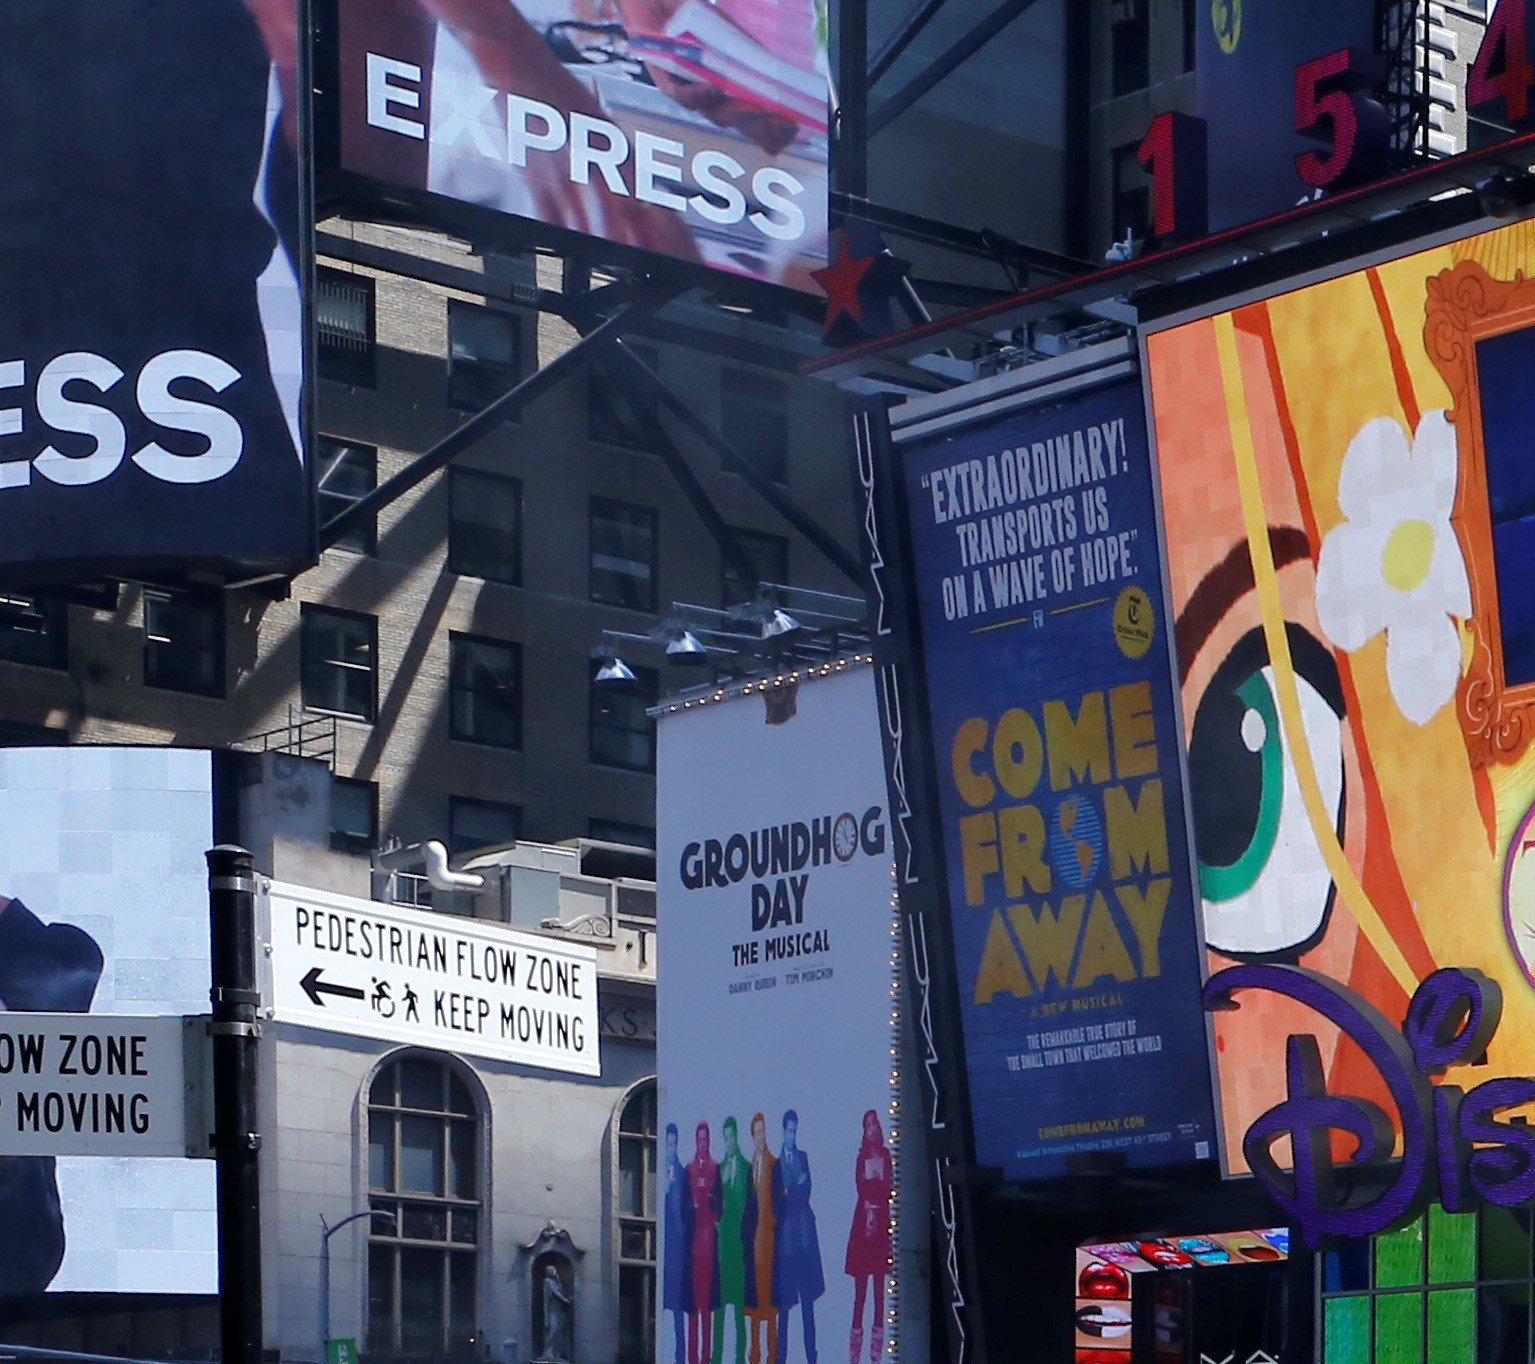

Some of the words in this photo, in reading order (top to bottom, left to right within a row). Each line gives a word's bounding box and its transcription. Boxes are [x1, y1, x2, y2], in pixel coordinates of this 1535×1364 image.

[365, 52, 806, 241] EXPRESS
[956, 495, 1078, 568] TRANSPORTS
[1082, 486, 1110, 535] US
[942, 575, 968, 621] ON
[973, 571, 987, 614] A
[988, 554, 1047, 609] WAVE
[1051, 547, 1075, 594] OF
[951, 681, 1159, 804] COME
[680, 806, 885, 890] GROUNDHOG
[960, 779, 1169, 908] FROM
[752, 874, 809, 932] DAY
[972, 878, 1171, 1006] AWAY
[295, 907, 448, 976] PEDESTRIAN
[457, 939, 518, 987] FLOW
[526, 954, 583, 1001] ZONE
[732, 941, 758, 967] THE
[765, 929, 830, 962] MUSICAL
[432, 987, 491, 1036] KEEP
[499, 1004, 586, 1053] MOVING
[1072, 992, 1124, 1010] MUSICAL
[59, 1034, 148, 1076] ZONE
[17, 1092, 149, 1134] MOVING
